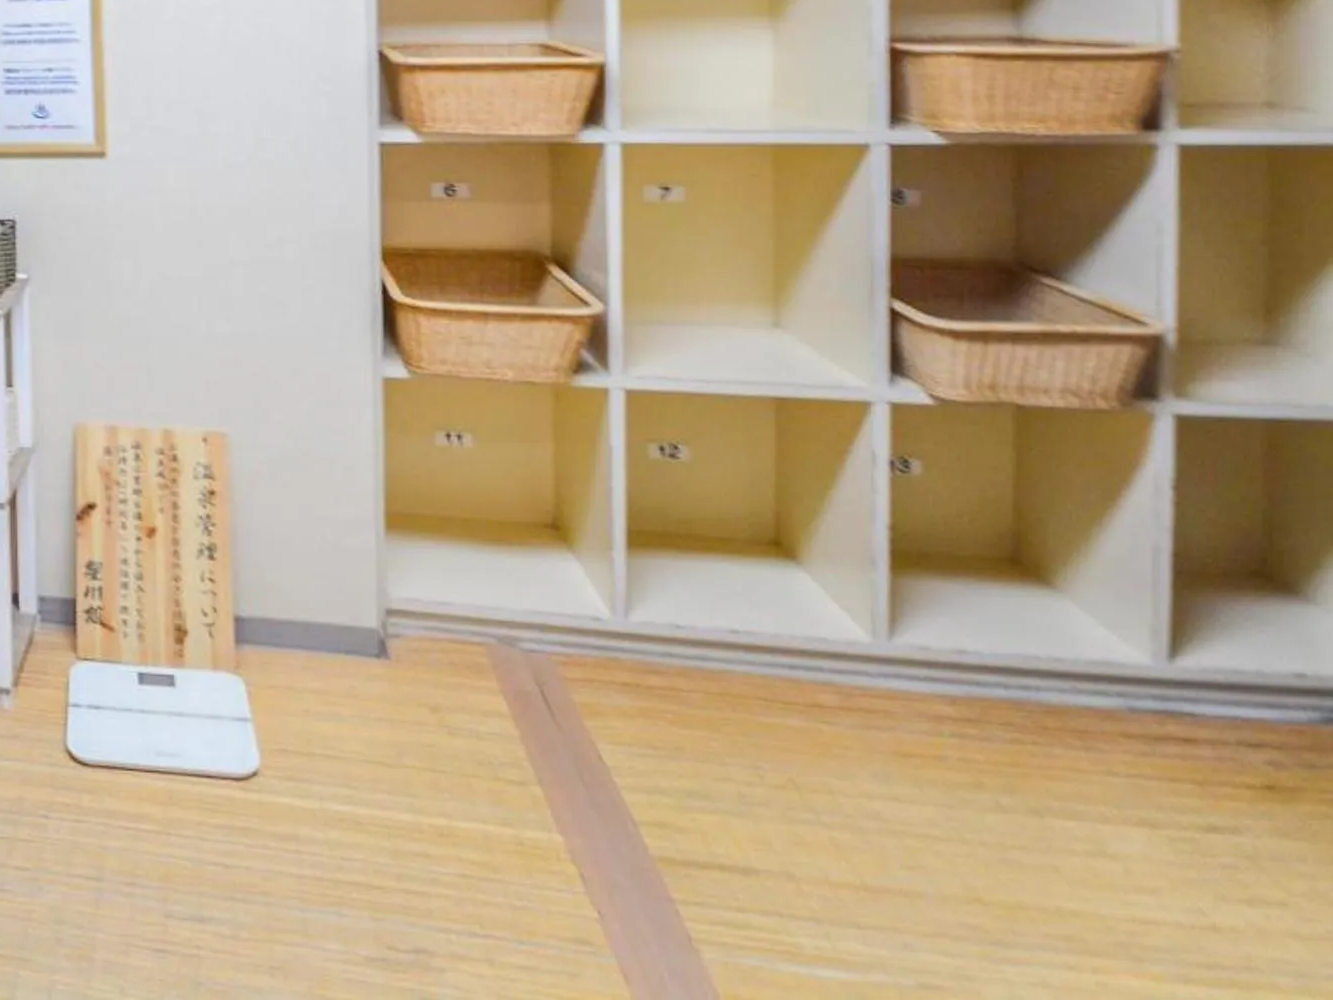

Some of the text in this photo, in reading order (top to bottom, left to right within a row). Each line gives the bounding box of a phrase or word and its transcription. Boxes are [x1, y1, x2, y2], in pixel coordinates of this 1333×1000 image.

[443, 183, 457, 199] 6
[656, 185, 672, 201] 7
[444, 432, 465, 446] 11
[657, 444, 682, 460] 12
